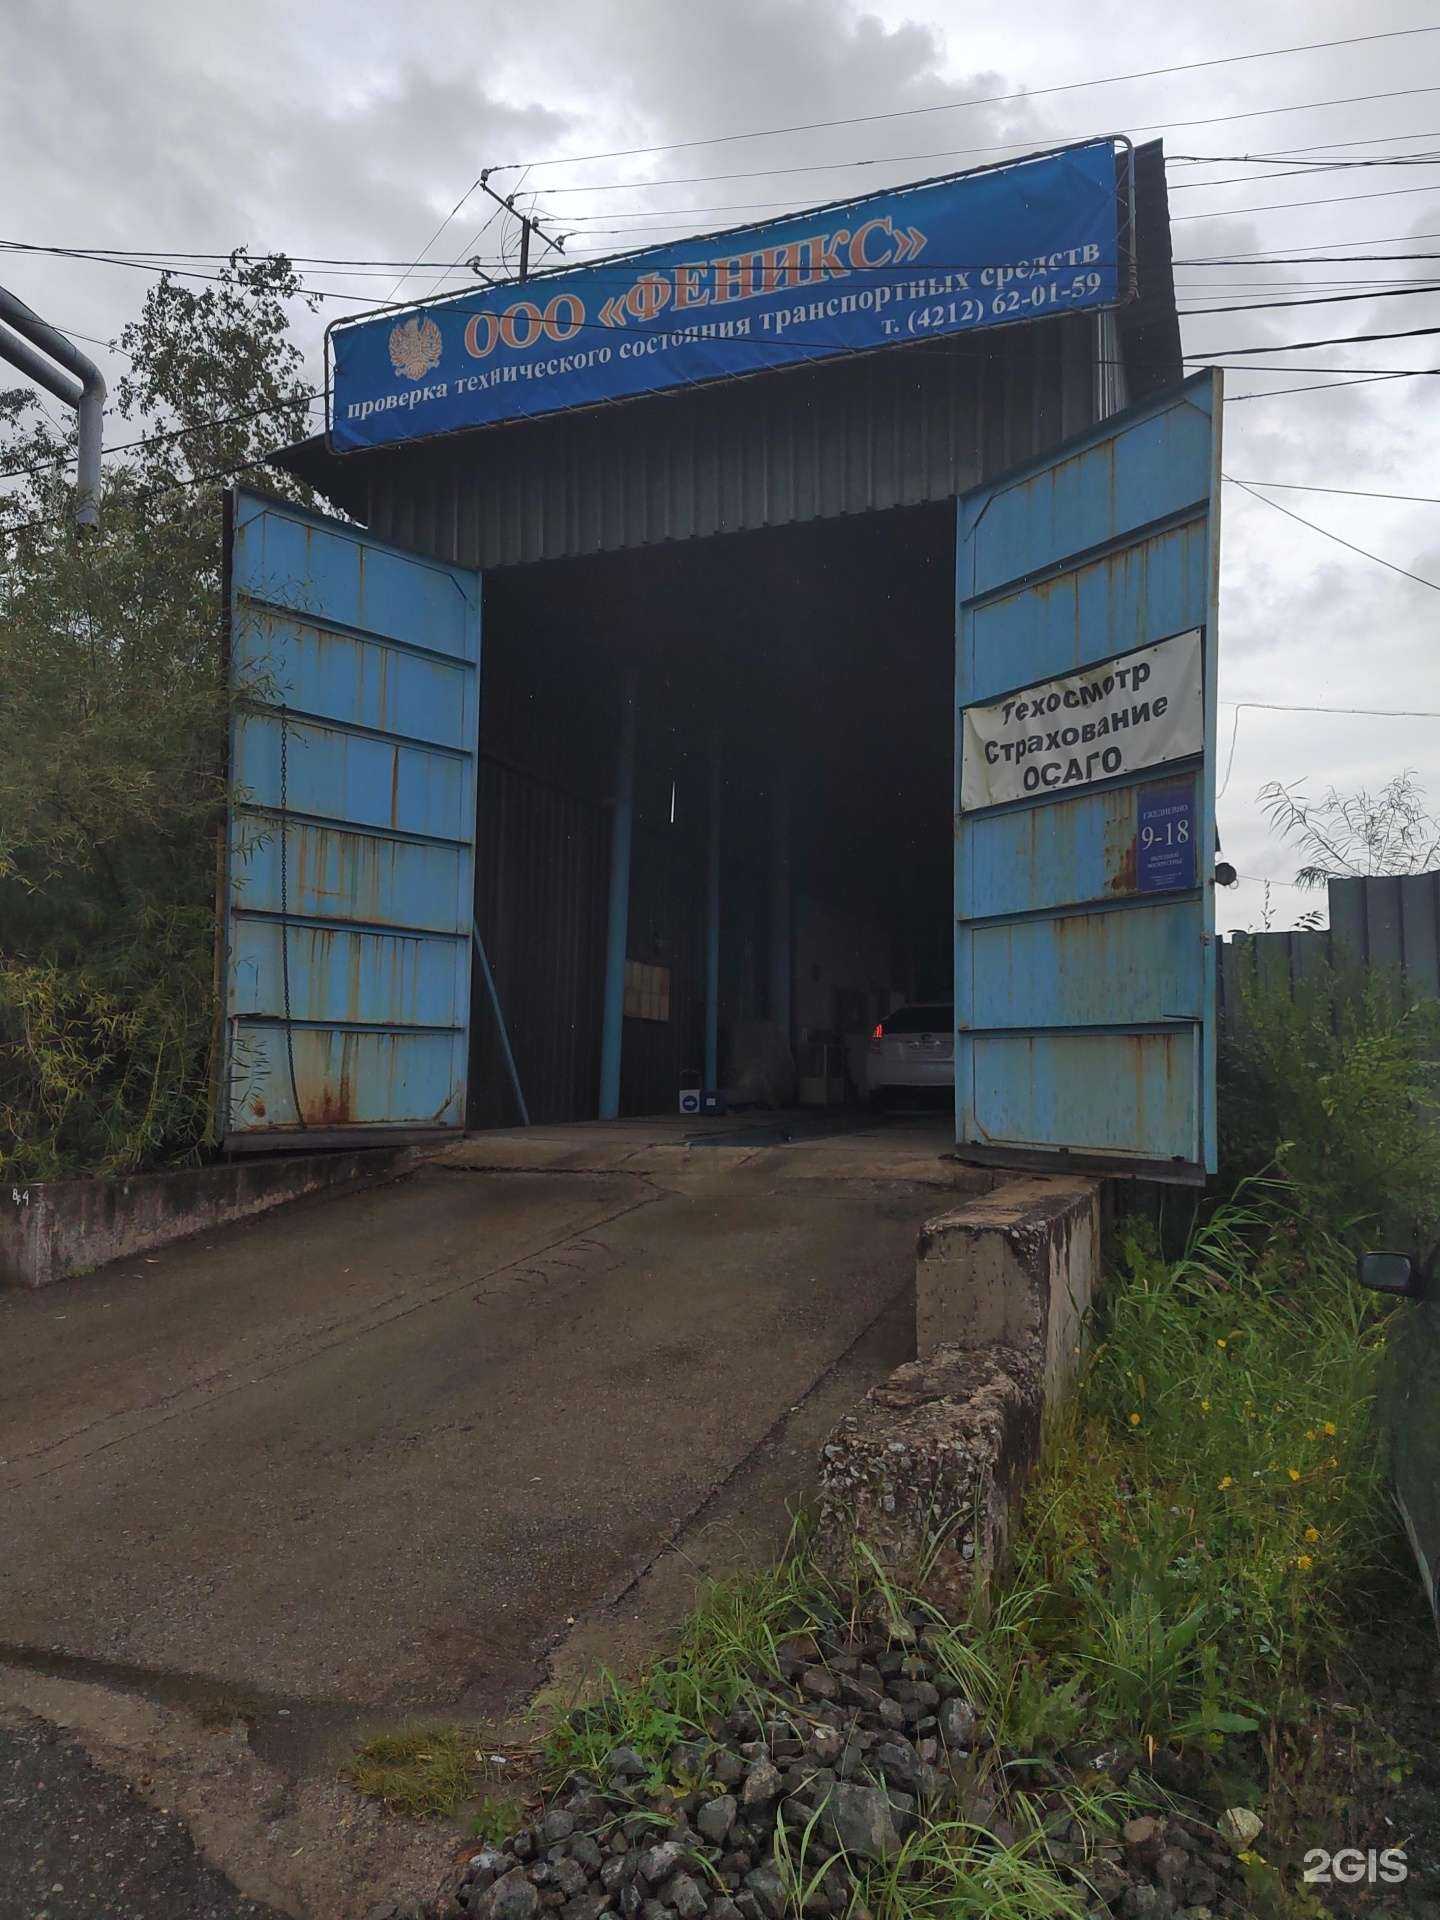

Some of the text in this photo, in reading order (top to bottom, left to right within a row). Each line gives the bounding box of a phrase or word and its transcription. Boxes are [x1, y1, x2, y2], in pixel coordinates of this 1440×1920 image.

[464, 215, 928, 359] ООО «ФЕНИКС»
[881, 272, 1102, 335] т. (4212) 62-01-59
[347, 243, 1100, 420] проверка технического состояния транспортных средств
[1001, 661, 1150, 725] Техосмотр
[984, 696, 1168, 764] Страхование
[1023, 746, 1122, 791] ОСАГО
[1141, 819, 1189, 850] 9-18
